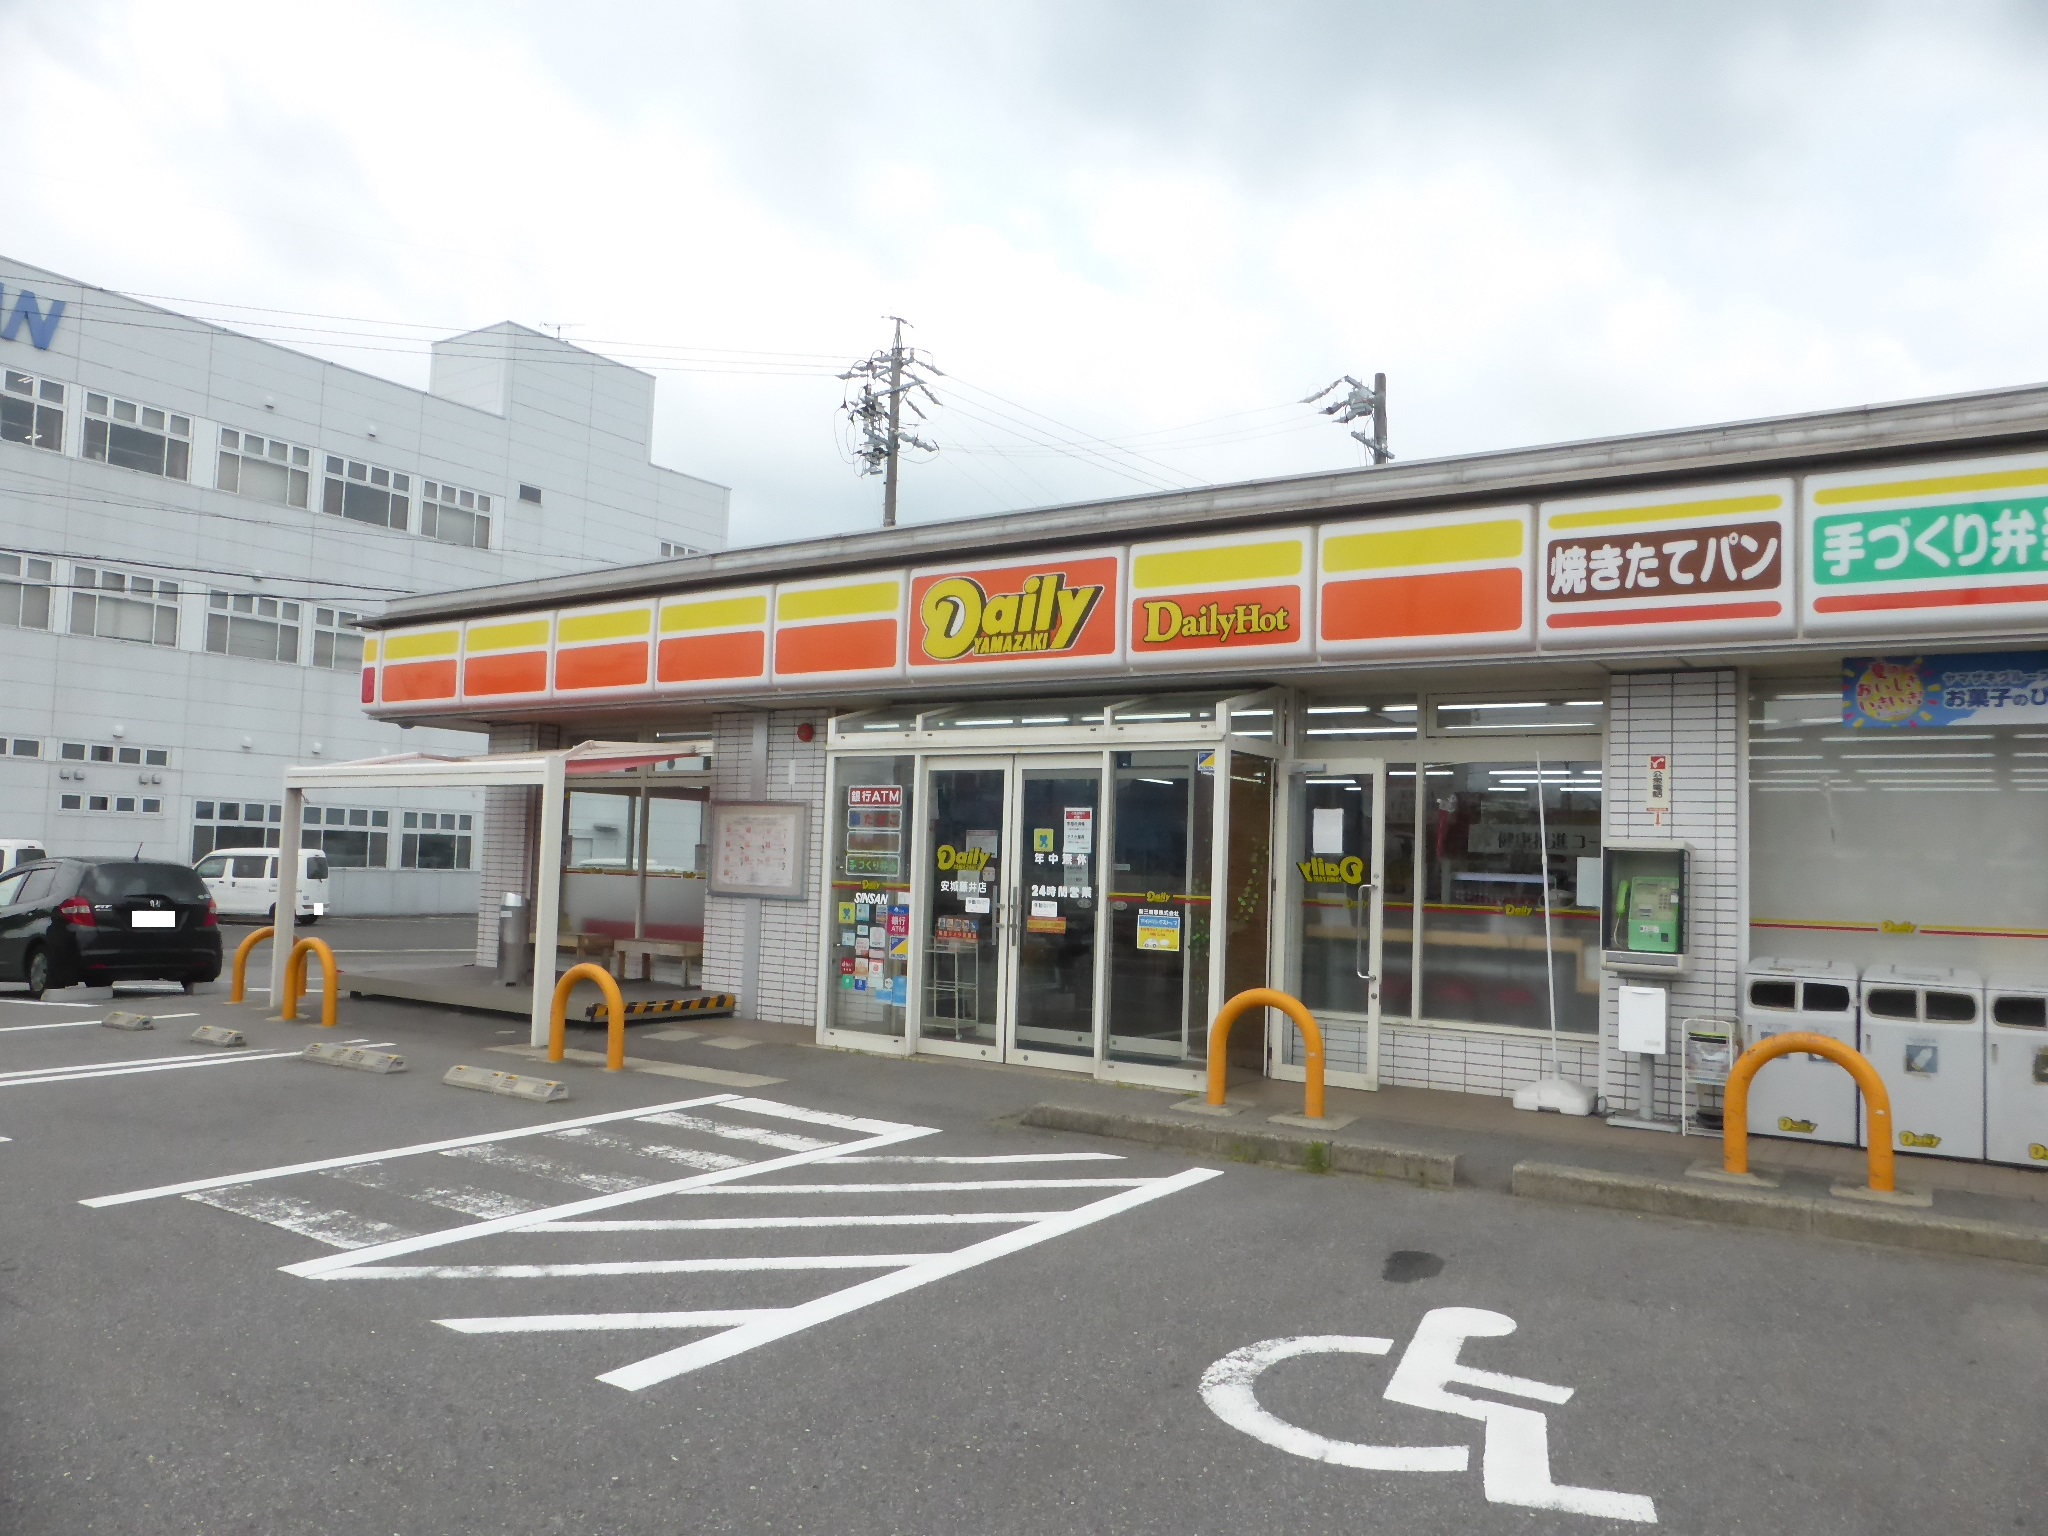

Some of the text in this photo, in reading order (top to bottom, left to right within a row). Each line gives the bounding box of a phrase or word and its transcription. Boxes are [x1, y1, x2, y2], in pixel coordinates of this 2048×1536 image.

[1822, 507, 2048, 577] 手づくり弁
[1550, 535, 1779, 595] 焼きたてパン
[921, 572, 1104, 660] Daily
[974, 631, 1048, 655] YAMAZAKI
[851, 790, 900, 803] 銀行ATM
[937, 844, 992, 872] Daily
[1034, 853, 1087, 866] 年中無休
[940, 880, 987, 893] 安城藤井店
[1031, 884, 1092, 899] 24時間営業
[853, 892, 889, 905] SINSAN
